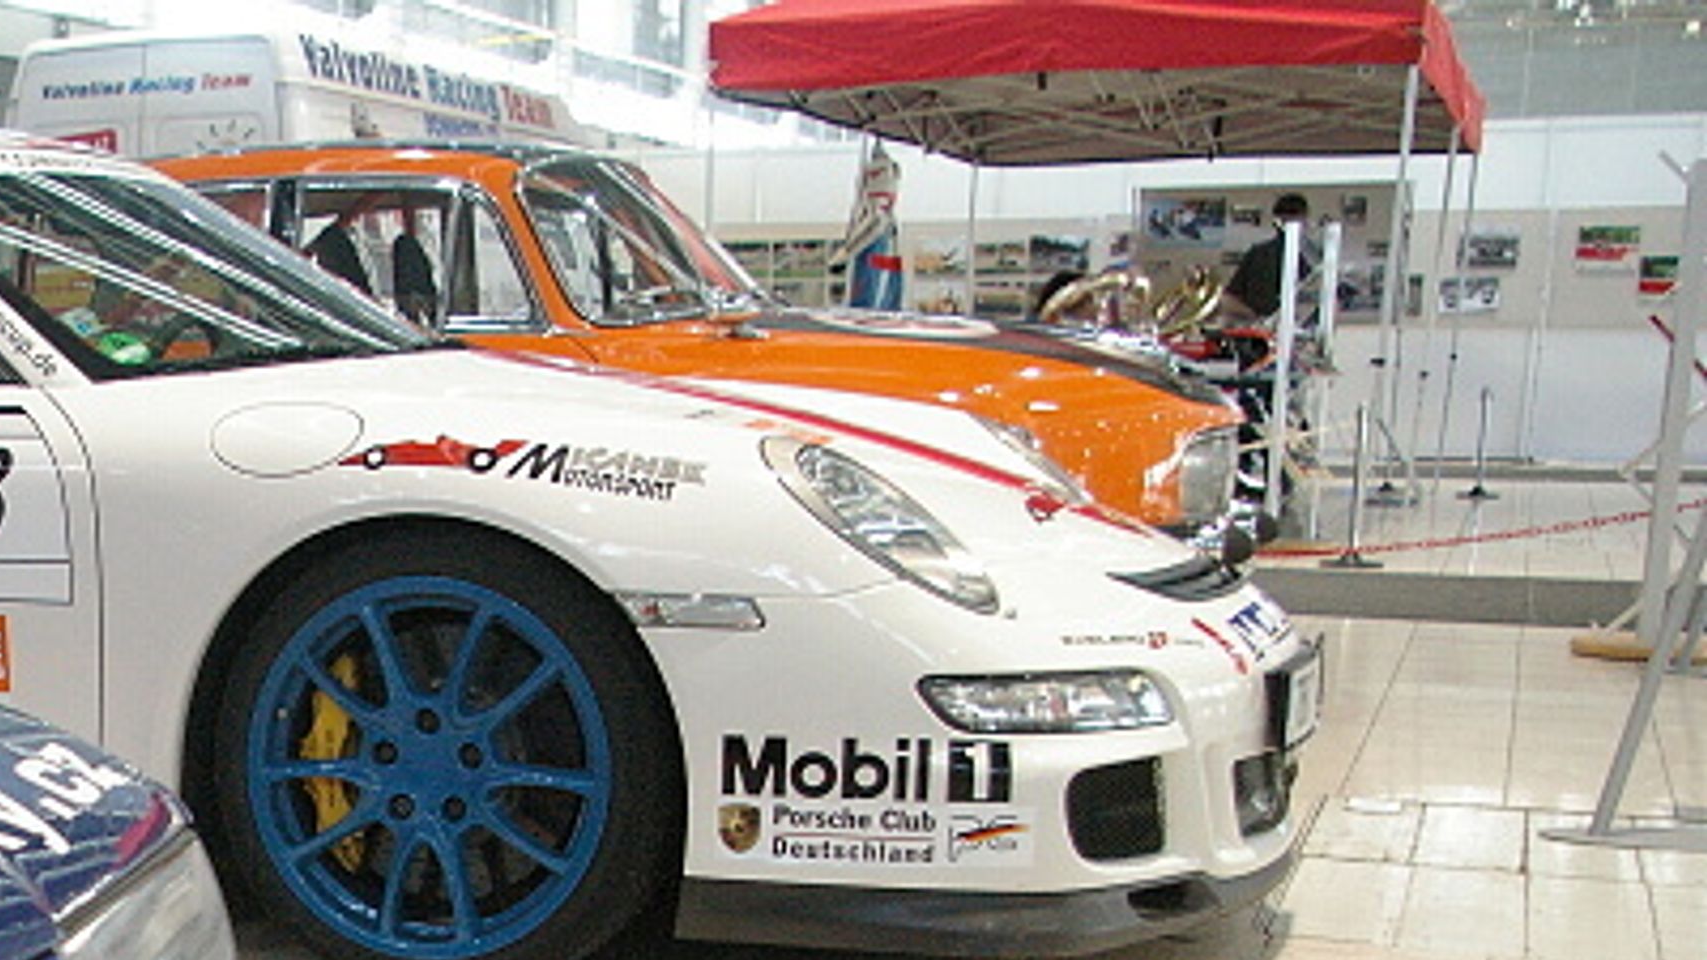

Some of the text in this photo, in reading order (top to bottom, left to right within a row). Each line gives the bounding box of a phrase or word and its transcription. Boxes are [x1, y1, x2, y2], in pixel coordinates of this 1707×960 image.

[43, 73, 252, 99] Valvoline Racing Team
[299, 34, 420, 99] Valvoline
[423, 64, 501, 122] Racing
[720, 734, 998, 801] Mobil 1
[772, 804, 938, 833] Porsche Club
[771, 836, 937, 864] Deutschland
